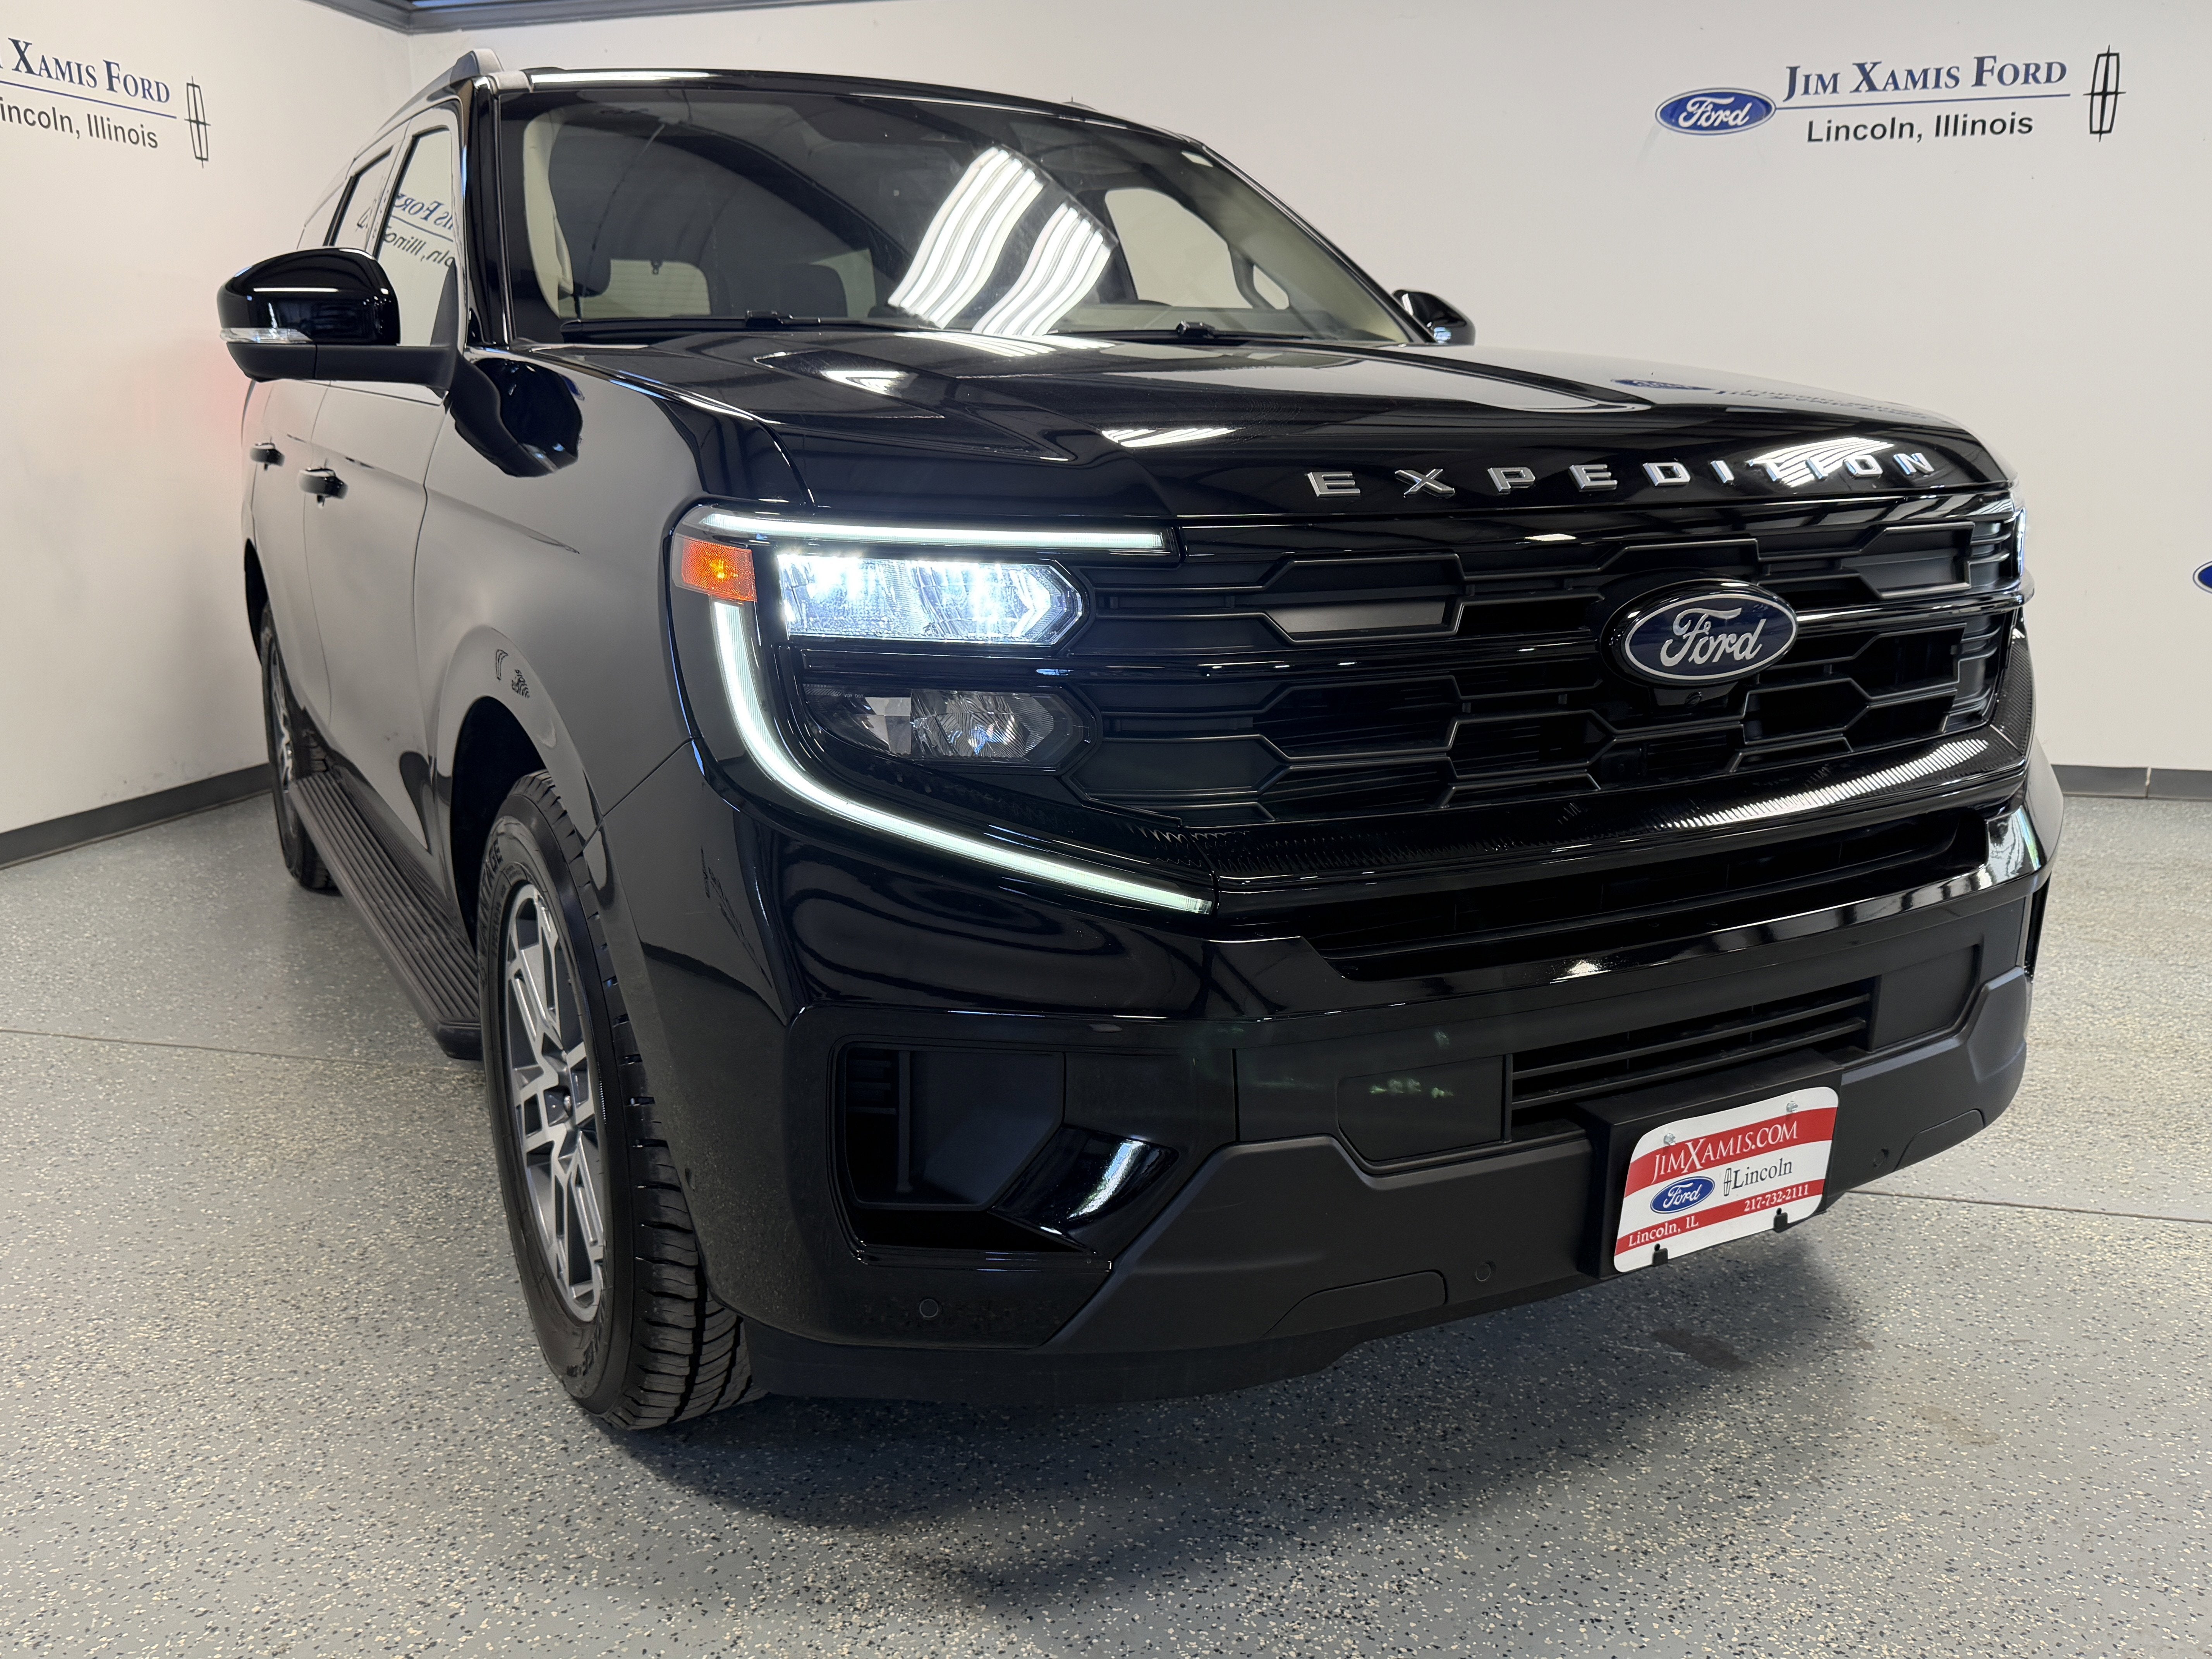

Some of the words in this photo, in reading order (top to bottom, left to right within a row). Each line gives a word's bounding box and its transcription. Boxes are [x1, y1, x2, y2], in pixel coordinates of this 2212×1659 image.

[8, 37, 98, 88] XAMIS
[103, 59, 170, 103] FORD
[1783, 65, 1840, 102] JIM
[1849, 60, 1960, 94] XAMIS
[1971, 55, 2067, 88] FORD
[0, 97, 80, 139] incoln,
[87, 113, 158, 148] Illinois
[1678, 96, 1752, 127] Ford
[1807, 117, 1923, 143] Lincoln,
[1935, 112, 2033, 138] Illinois
[1307, 452, 1935, 497] EXPEDITION
[1660, 607, 1767, 667] Ford
[1651, 1120, 1798, 1184] JIMXAMIS.COM
[1731, 1158, 1793, 1190] Lincoln
[1663, 1182, 1702, 1209] Ford
[1744, 1185, 1808, 1212] 217-732-2111
[1628, 1222, 1681, 1247] Lincoln,
[1686, 1215, 1699, 1229] IL
